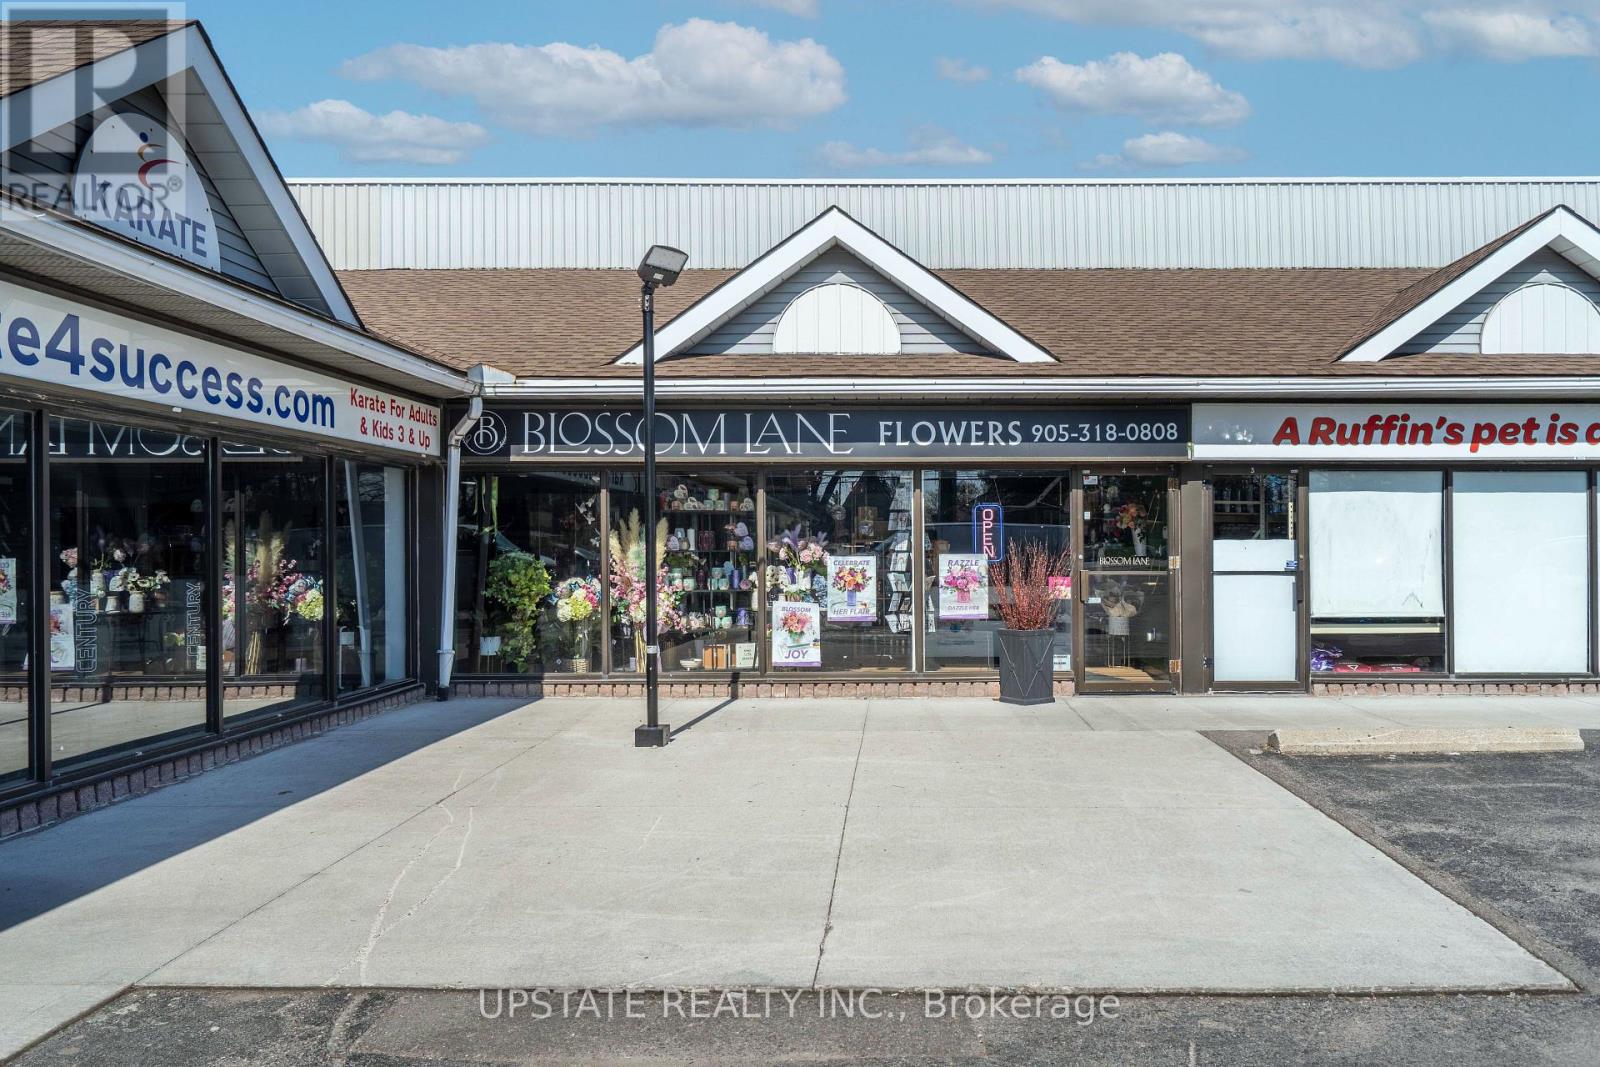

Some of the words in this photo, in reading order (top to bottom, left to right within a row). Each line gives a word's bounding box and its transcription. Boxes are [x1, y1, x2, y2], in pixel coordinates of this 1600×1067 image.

[91, 174, 208, 258] KARATE
[0, 313, 336, 428] e4success.com
[350, 387, 386, 413] Karate
[390, 399, 406, 419] For
[408, 405, 438, 427] Adults
[360, 416, 368, 435] &
[372, 419, 394, 441] Kids
[398, 425, 405, 443] 3
[408, 428, 415, 445] &
[419, 430, 431, 451] Up
[521, 411, 727, 455] BLOSSOM
[744, 412, 853, 455] LANE
[879, 420, 1023, 447] FLOWERS
[1031, 423, 1178, 443] 905-318-0808
[1272, 416, 1300, 446] A
[1308, 413, 1465, 446] Ruffin's
[1469, 417, 1541, 454] pet
[1545, 413, 1580, 446] is
[982, 508, 995, 559] OPEN
[947, 559, 979, 567] RAZZLE
[1099, 556, 1130, 566] BLOSSOM
[76, 588, 97, 673] CENTURY
[784, 649, 808, 660] JOY
